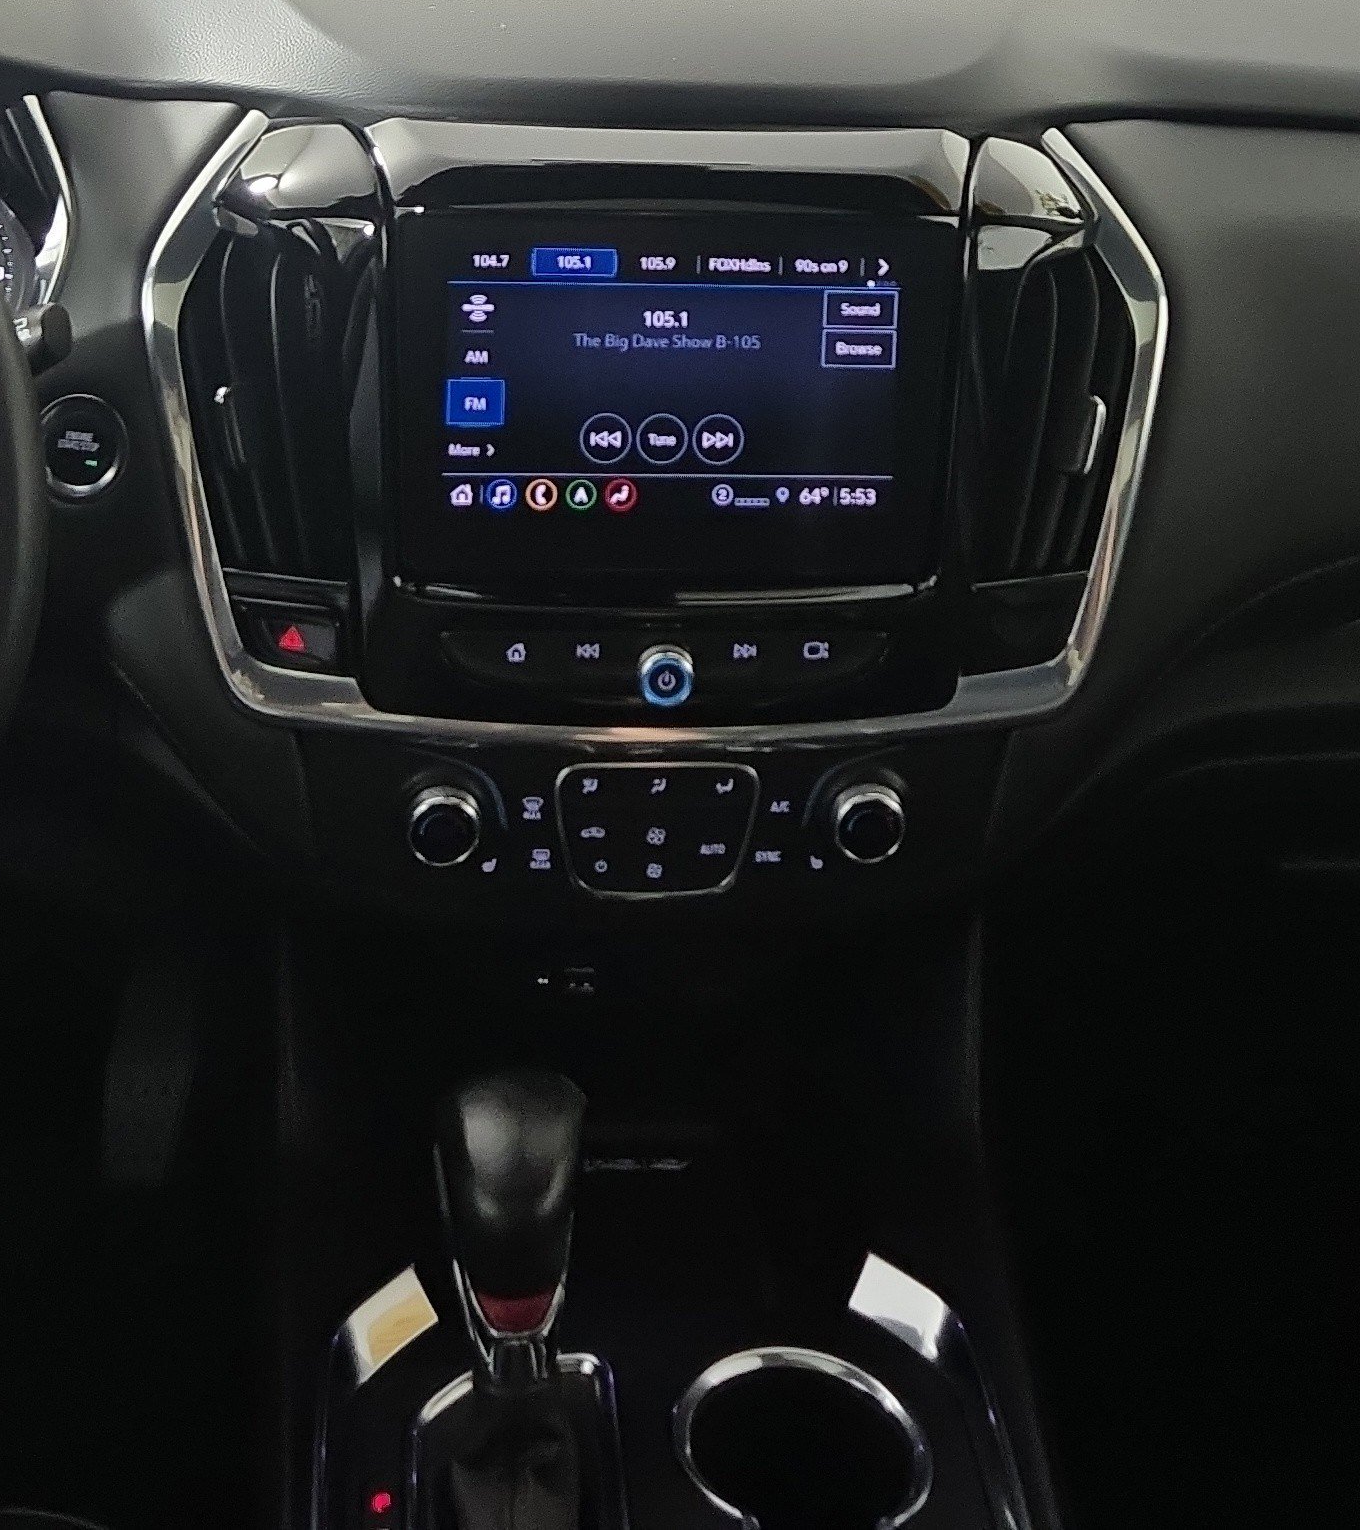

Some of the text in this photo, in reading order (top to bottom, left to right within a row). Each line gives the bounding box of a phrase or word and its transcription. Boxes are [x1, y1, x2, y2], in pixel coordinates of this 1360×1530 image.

[472, 254, 510, 268] 104.7
[556, 255, 592, 270] 105.1
[640, 256, 677, 271] 105.9
[840, 302, 881, 317] Sound
[643, 310, 689, 328] 105.1
[573, 333, 762, 352] The Big Dave Show B-105
[835, 340, 883, 356] Browse
[464, 350, 489, 364] AM
[463, 396, 487, 411] FM
[647, 432, 678, 447] Tune
[448, 443, 481, 457] More
[839, 487, 877, 506] 5:53
